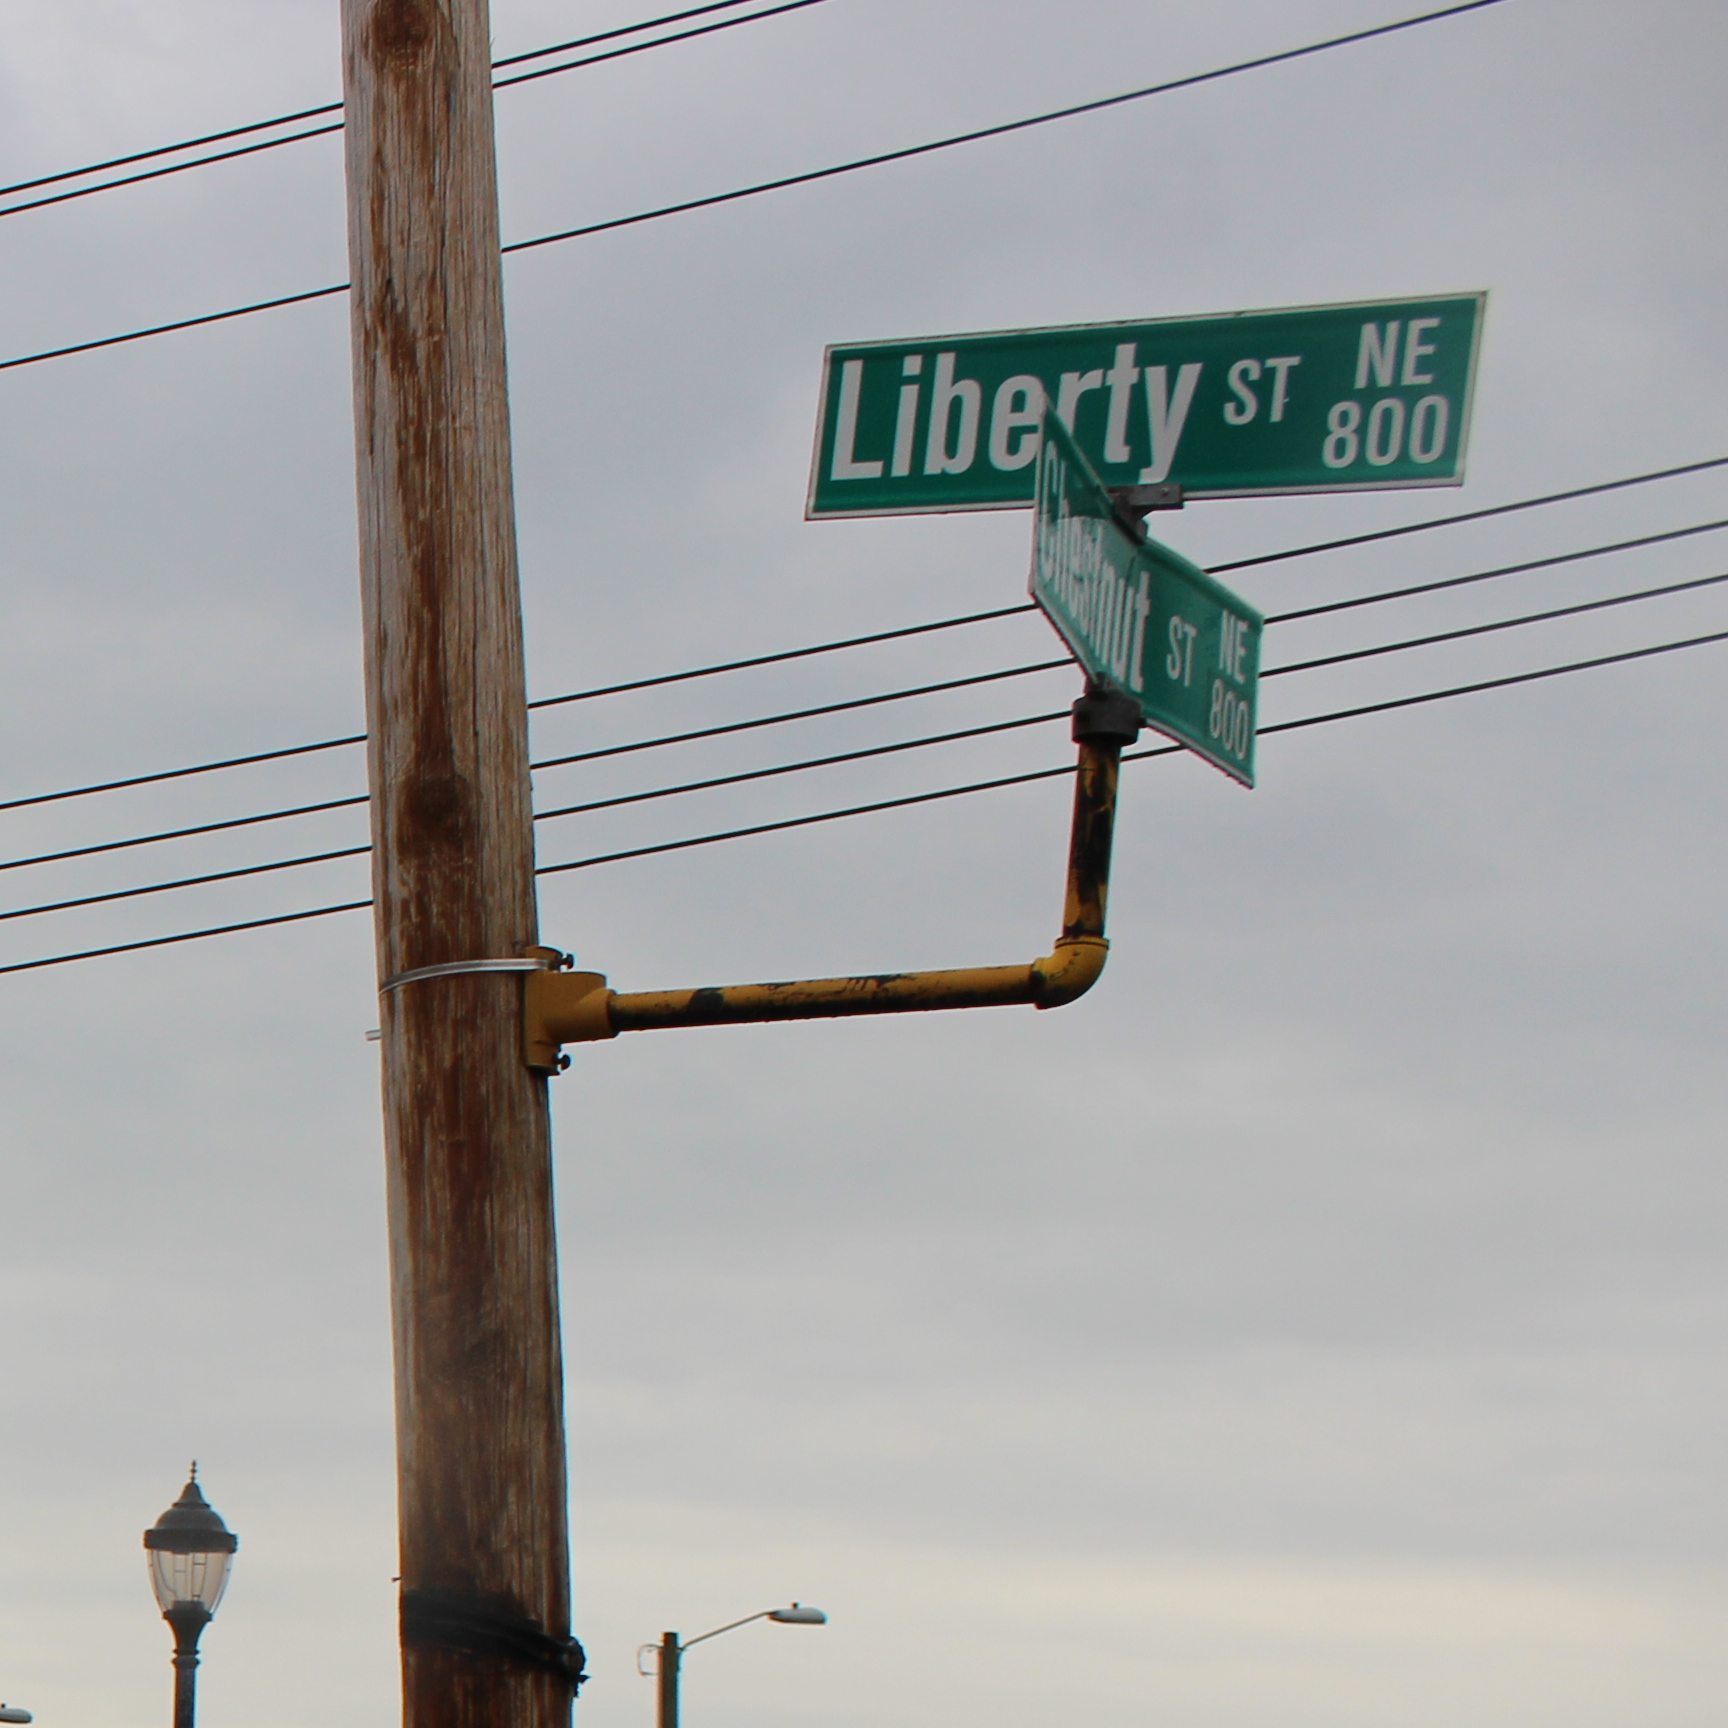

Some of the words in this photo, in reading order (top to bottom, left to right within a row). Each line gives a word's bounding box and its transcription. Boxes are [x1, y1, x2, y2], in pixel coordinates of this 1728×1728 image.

[830, 342, 1203, 486] Liberty
[1223, 356, 1301, 427] ST
[1354, 317, 1441, 389] NE
[1321, 395, 1450, 469] 800
[1166, 614, 1198, 687] ST
[1218, 607, 1250, 684] NE
[1209, 678, 1249, 761] 800
